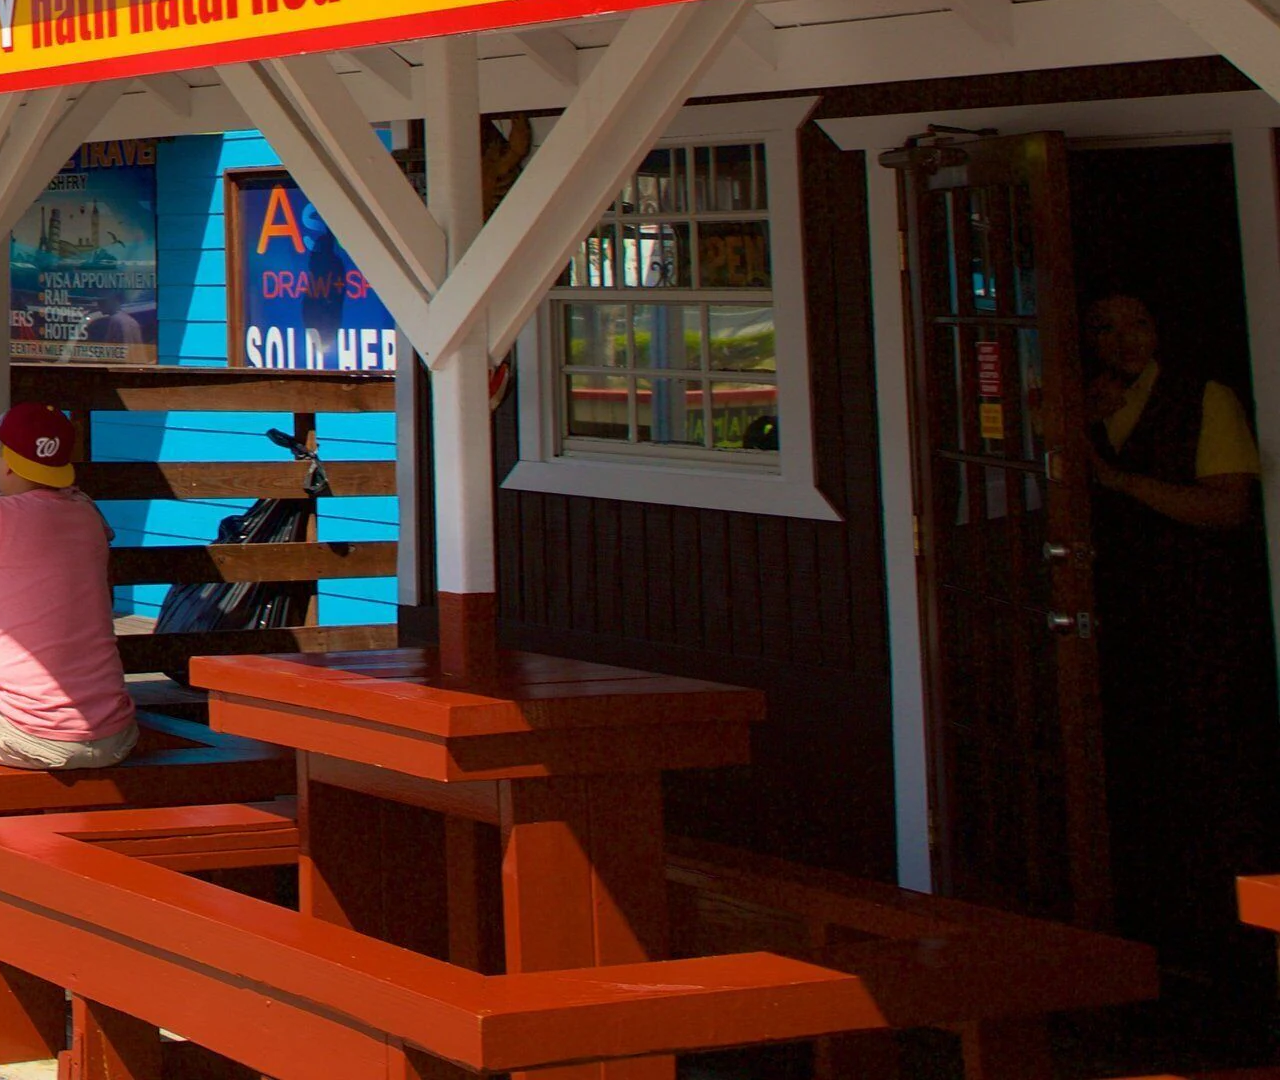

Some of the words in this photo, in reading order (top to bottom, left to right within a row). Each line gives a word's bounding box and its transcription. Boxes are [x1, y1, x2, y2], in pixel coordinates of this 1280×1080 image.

[45, 271, 70, 288] VISA
[45, 289, 71, 306] RAIL
[44, 323, 89, 340] HOTELS
